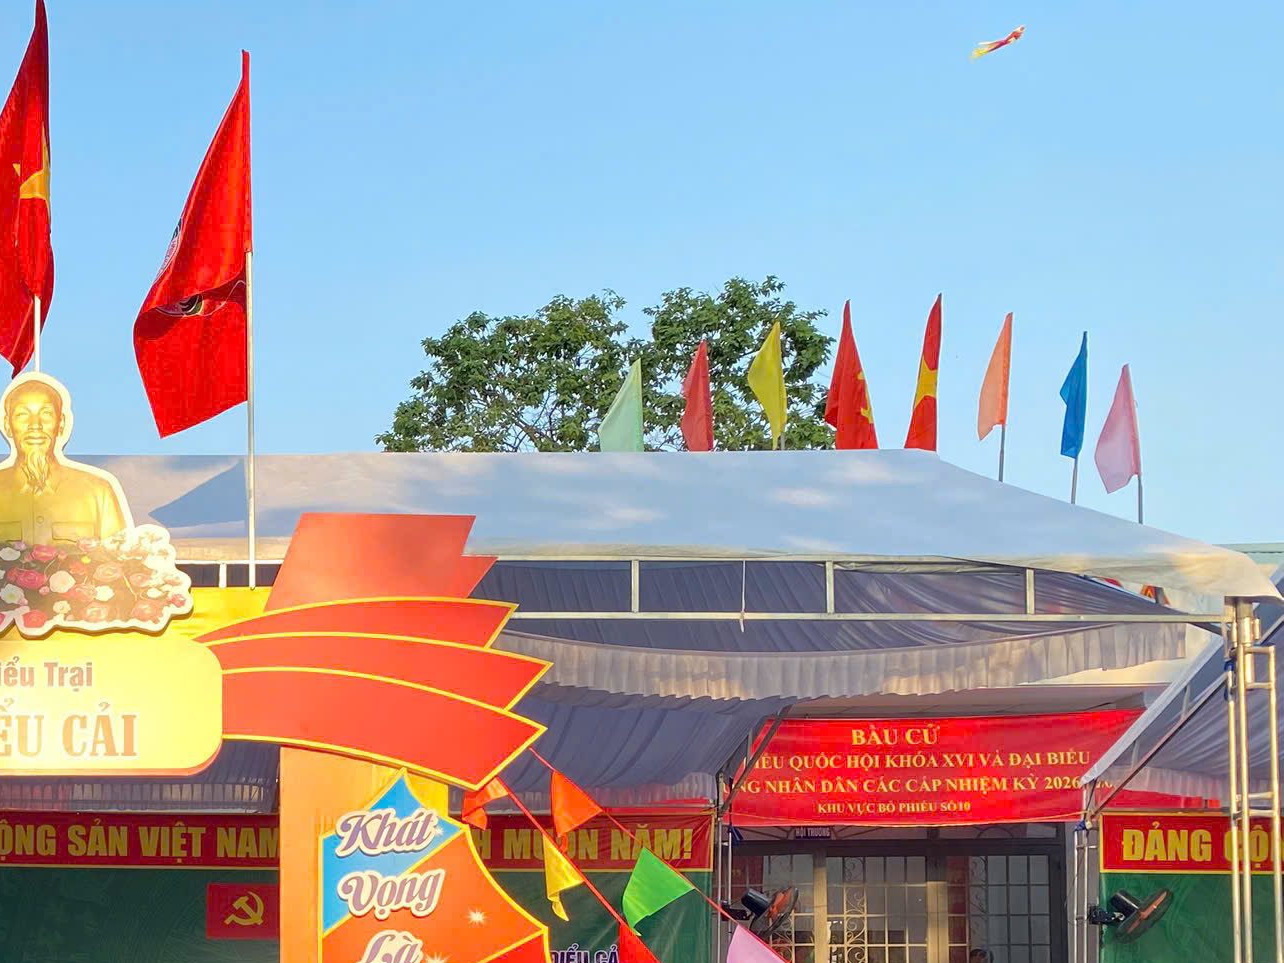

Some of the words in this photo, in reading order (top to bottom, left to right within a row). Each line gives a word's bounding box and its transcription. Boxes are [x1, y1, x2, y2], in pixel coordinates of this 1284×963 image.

[44, 661, 92, 692] Trại
[62, 701, 136, 757] CẢI
[789, 752, 842, 771] QUỐC
[846, 753, 880, 772] HỘI
[885, 750, 939, 768] KHÓA
[942, 753, 974, 767] XVI
[1009, 752, 1041, 769] ĐẠI
[765, 777, 816, 793] NHÂN
[821, 776, 858, 793] DÂN
[863, 775, 901, 793] CÁC
[945, 776, 1007, 795] NHIỆM
[1013, 773, 1039, 790] KỲ
[1044, 776, 1081, 790] 2026
[817, 802, 844, 814] KHU
[67, 818, 128, 857] SẢN
[138, 820, 206, 863] VIỆT
[217, 826, 279, 858] NAM
[611, 823, 693, 860] NĂM!
[340, 811, 436, 852] Khát
[1121, 821, 1212, 862] ĐẢNG
[341, 872, 441, 915] Vọng
